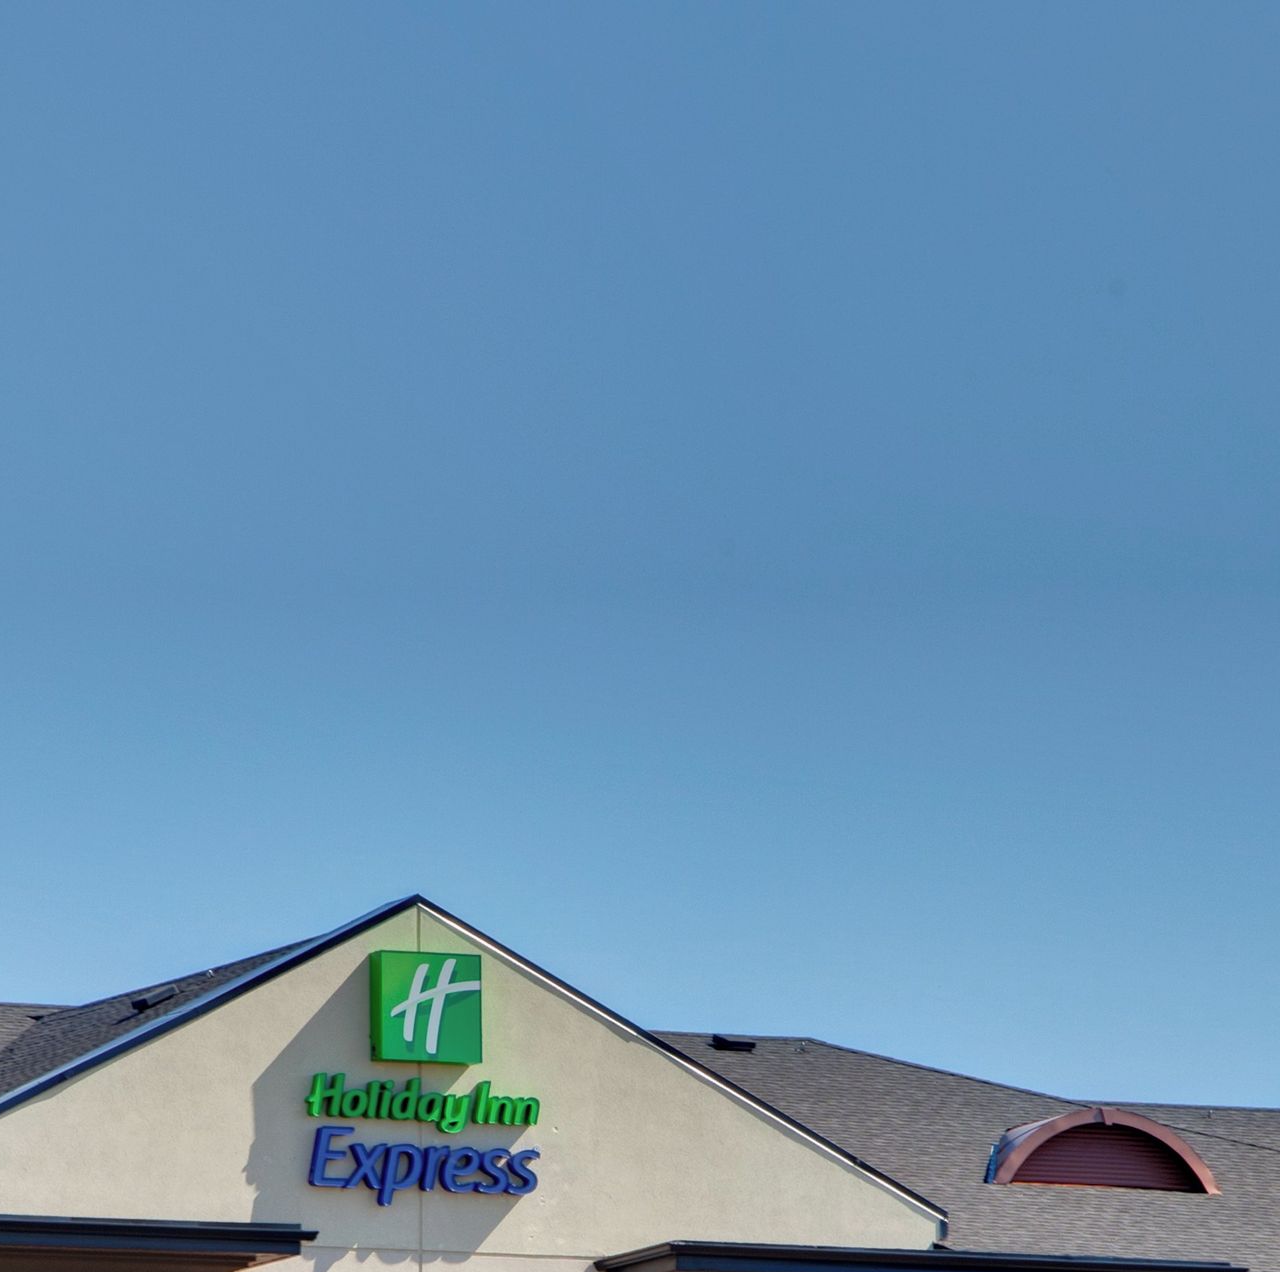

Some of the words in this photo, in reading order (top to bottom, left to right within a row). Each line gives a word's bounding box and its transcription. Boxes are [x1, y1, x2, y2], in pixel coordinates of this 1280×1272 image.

[305, 1072, 469, 1134] Holiday
[472, 1080, 541, 1126] Inn
[308, 1125, 541, 1207] Express
